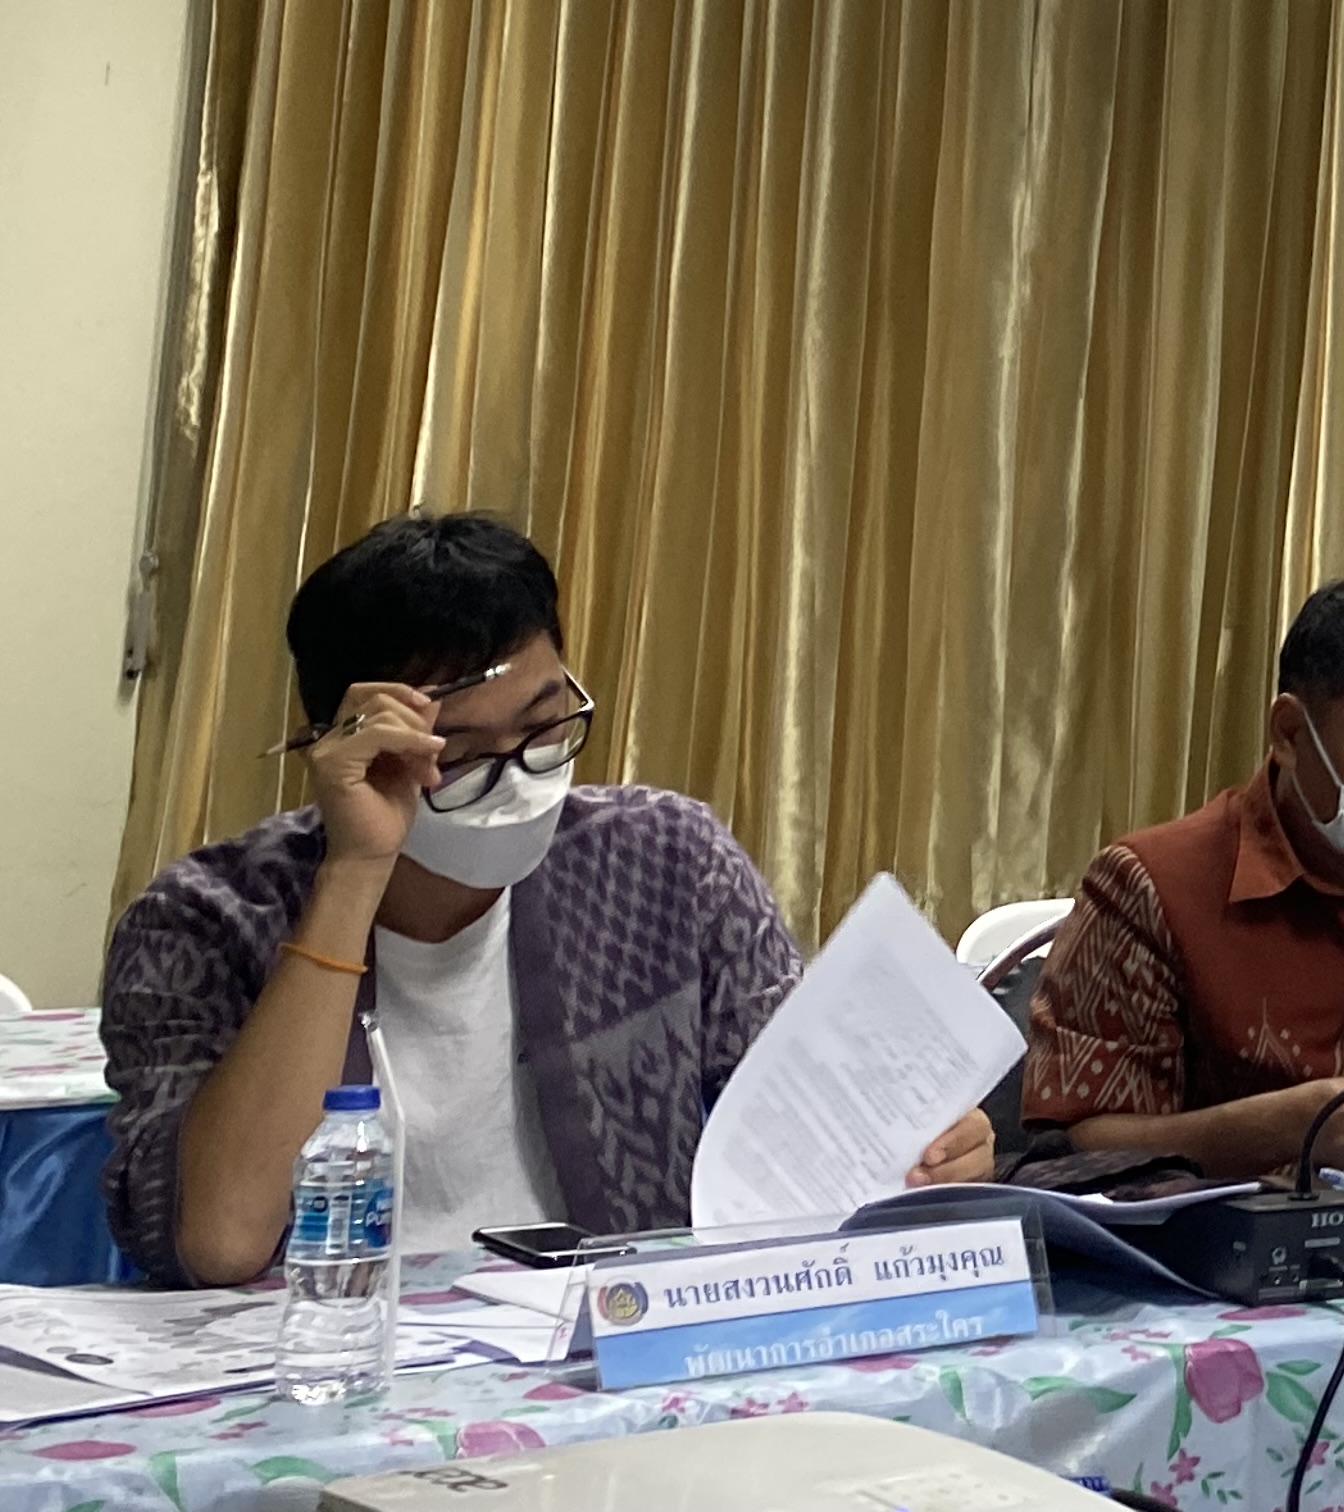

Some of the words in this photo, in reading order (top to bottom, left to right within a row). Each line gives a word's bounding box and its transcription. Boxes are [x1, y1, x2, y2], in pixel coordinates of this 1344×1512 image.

[664, 1244, 854, 1310] นายสงวนศักดิ์
